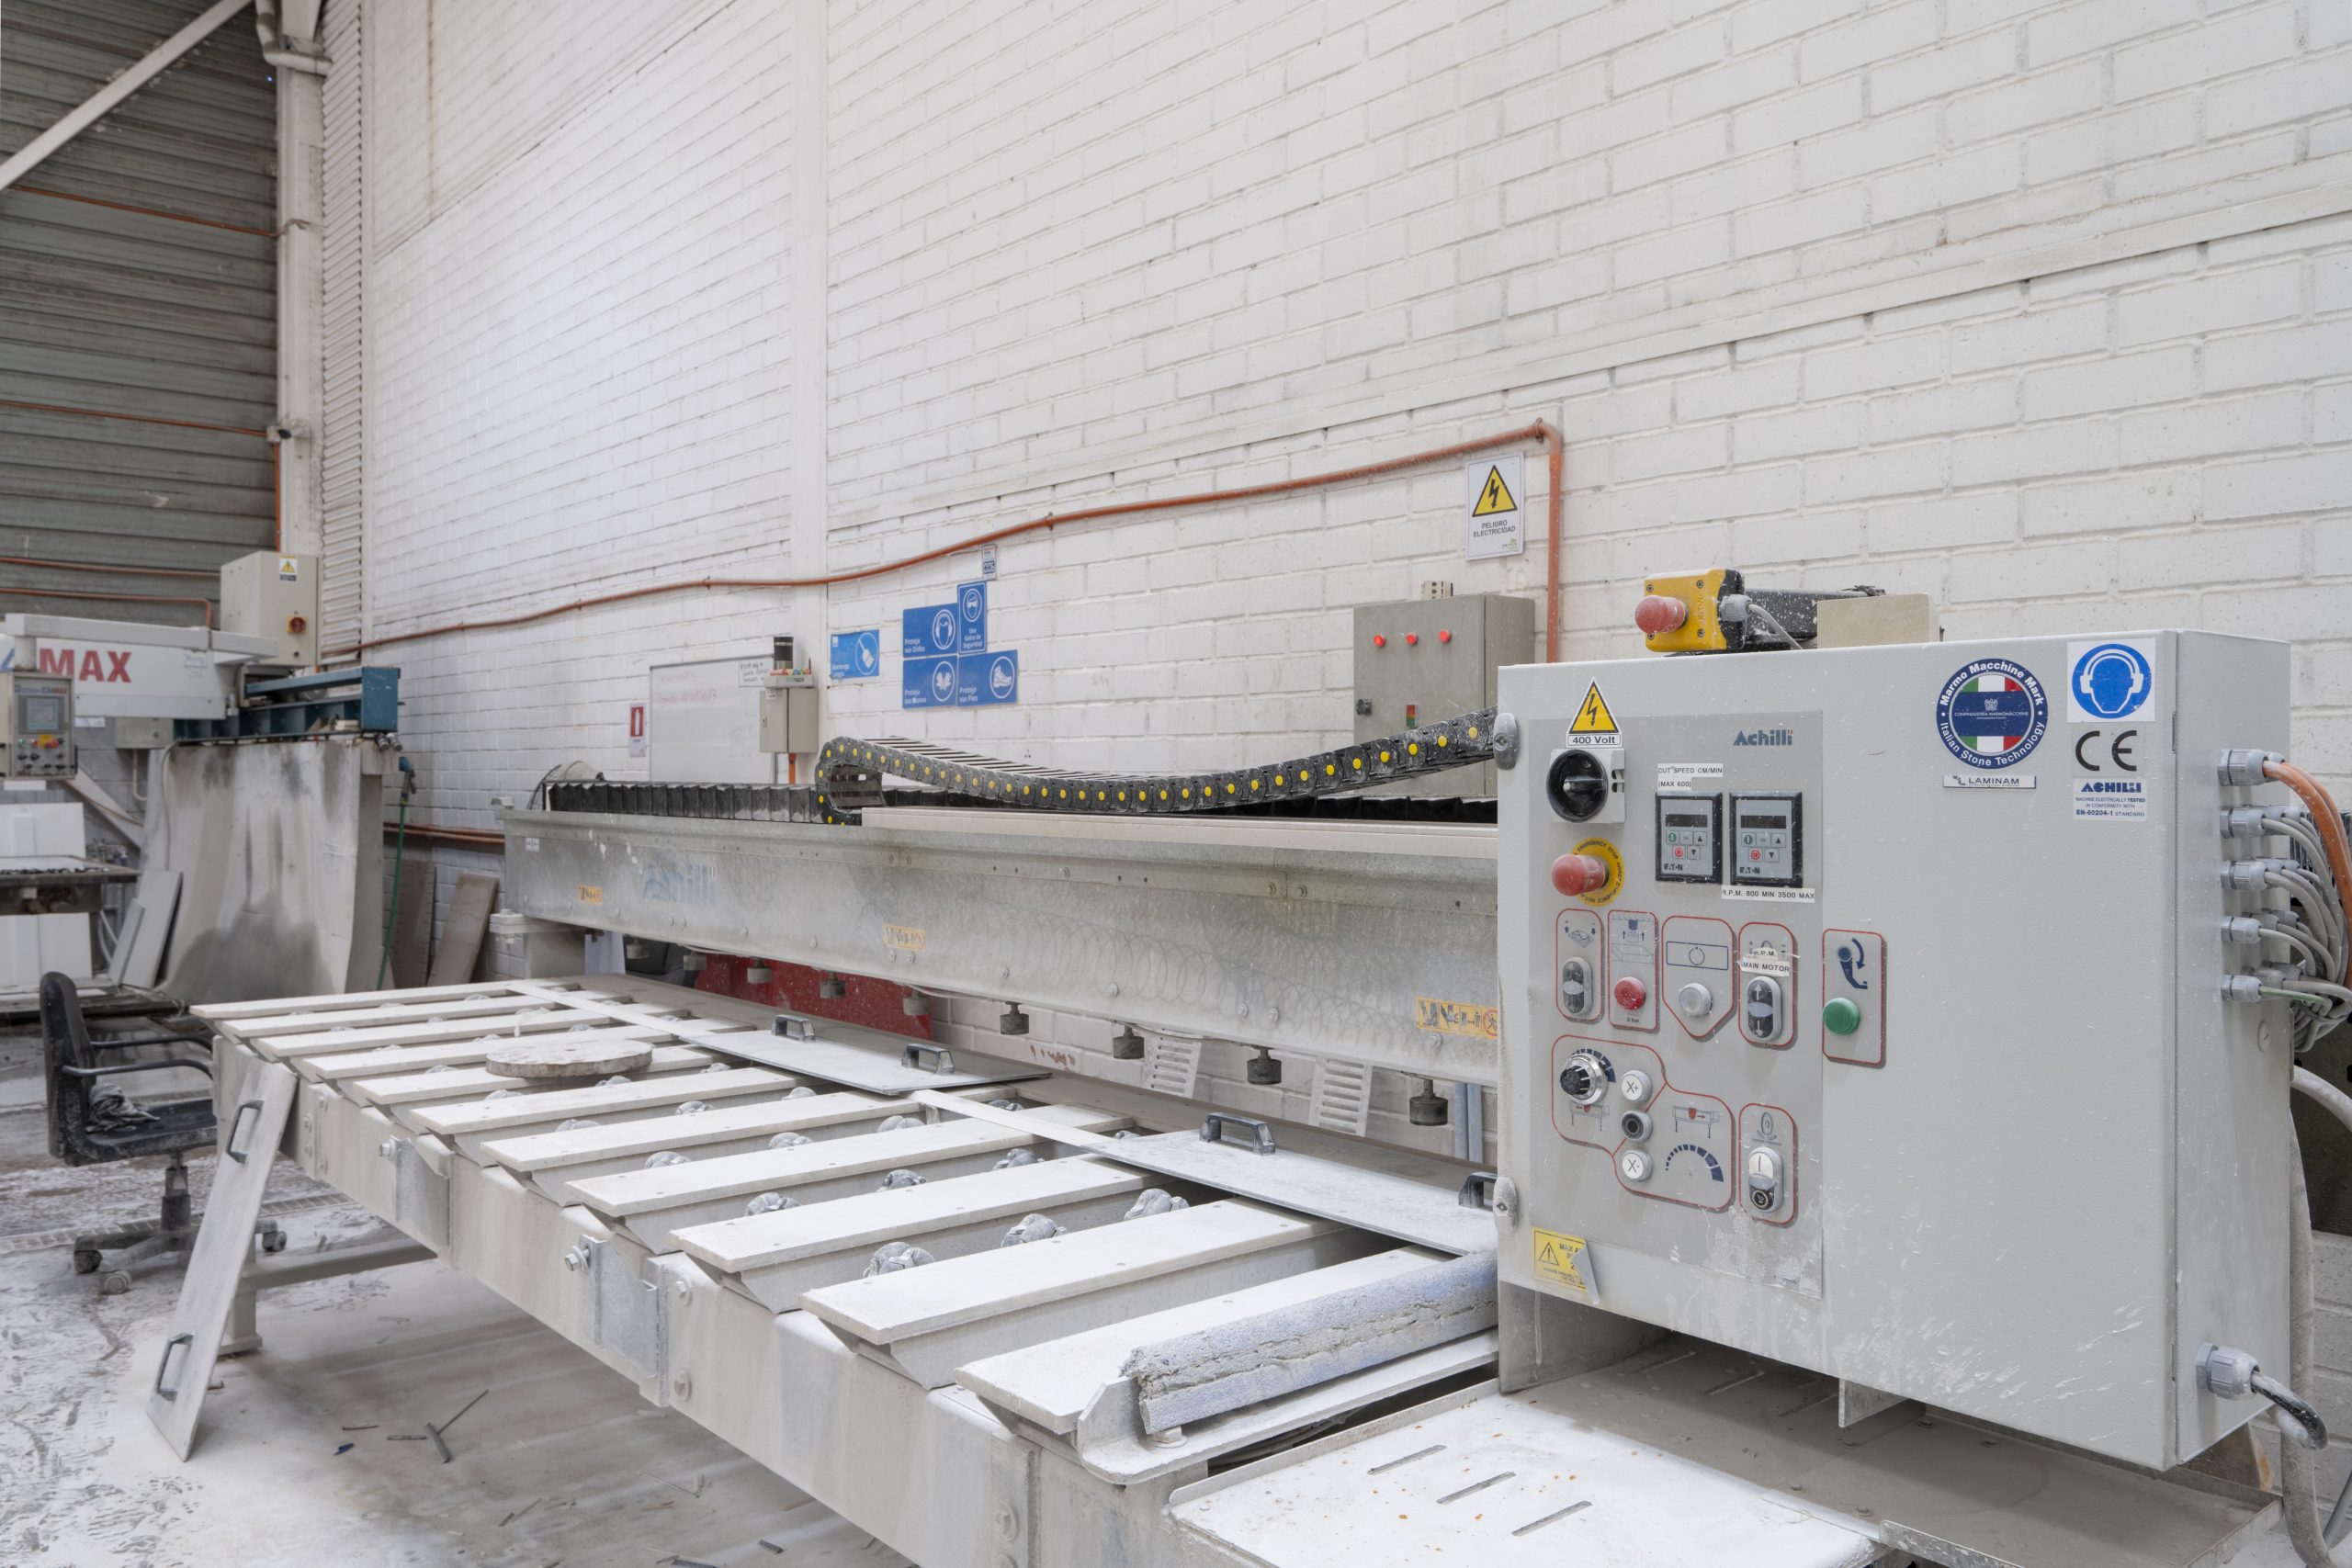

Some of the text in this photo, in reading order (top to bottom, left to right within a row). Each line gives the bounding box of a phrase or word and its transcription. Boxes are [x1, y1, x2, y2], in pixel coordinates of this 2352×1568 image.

[1473, 525, 1516, 537] ELECTRICIDAD
[1481, 519, 1508, 529] PELIGRO
[904, 637, 921, 646] Proteja
[40, 648, 132, 683] MAX
[1939, 660, 2044, 706] Marmo Macchine Mark
[959, 686, 977, 695] Proteja
[1572, 736, 1616, 744] 400 Volt
[1733, 729, 1793, 746] Achilli
[1939, 721, 2045, 766] Italian Stone Technology
[2075, 729, 2138, 772] CE
[2080, 782, 2142, 793] ACHILLI
[1577, 840, 1619, 860] EMERGENCY STOP
[1762, 964, 1790, 973] MOTOR
[1626, 1080, 1639, 1094] X+
[1627, 1158, 1640, 1173] X-
